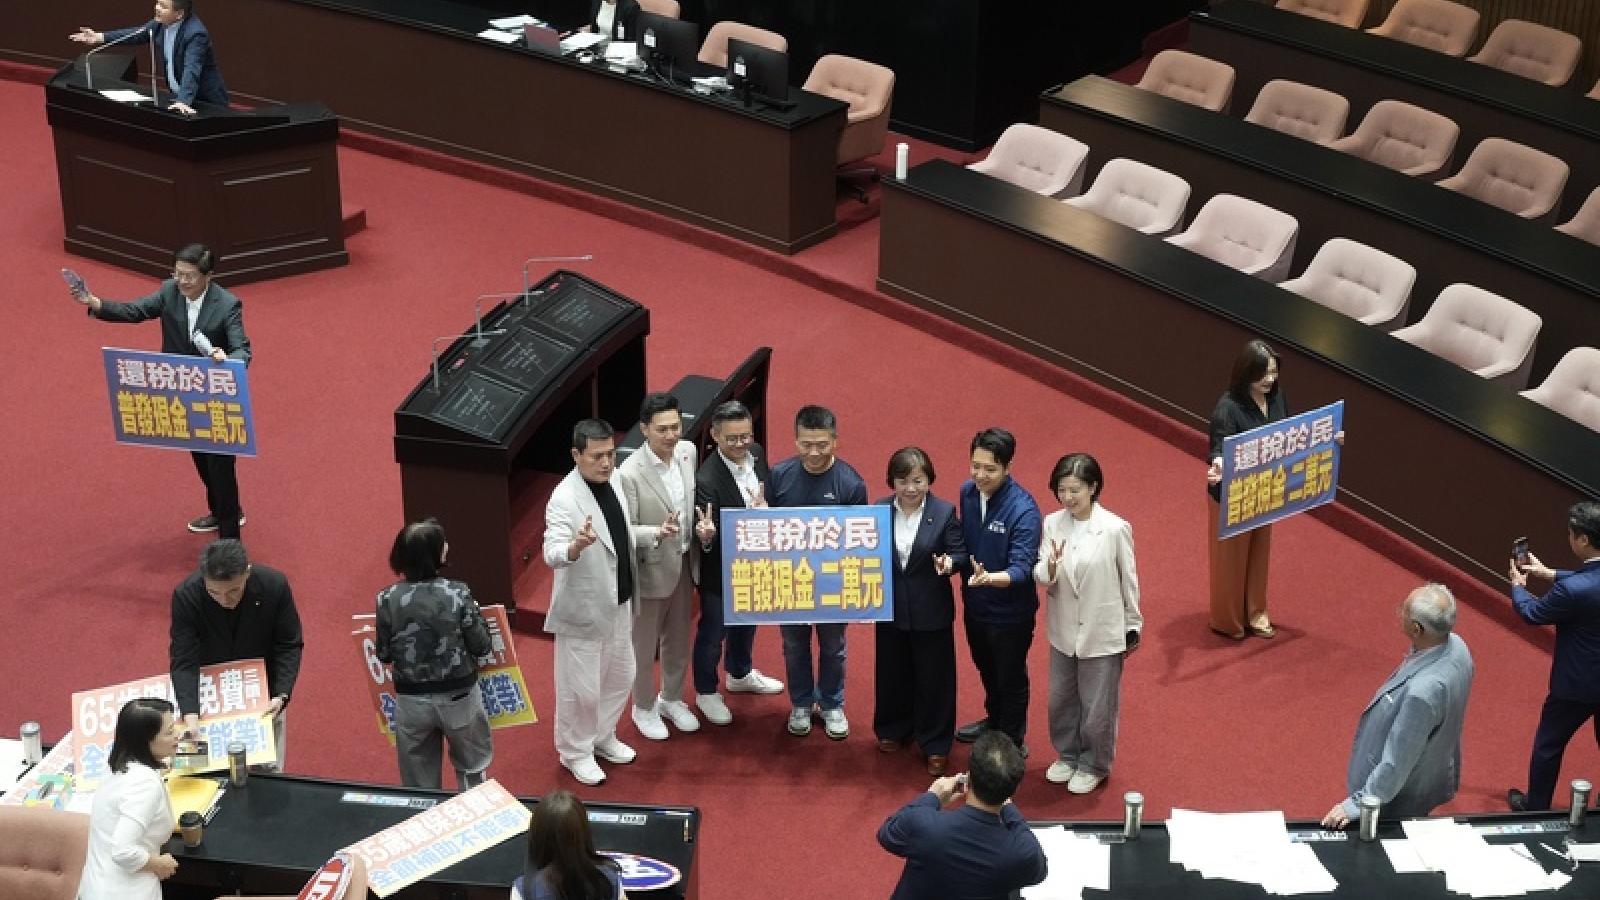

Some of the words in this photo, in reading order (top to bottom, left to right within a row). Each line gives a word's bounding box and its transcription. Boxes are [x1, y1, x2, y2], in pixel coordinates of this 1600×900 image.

[117, 358, 237, 396] 還稅於民
[117, 390, 190, 439] 普發現金
[192, 400, 247, 444] 二萬元
[1234, 414, 1333, 472] 還稅於民
[1226, 463, 1287, 526] 普發現金
[1288, 449, 1333, 502] 二萬元
[735, 516, 878, 552] 還稅於民
[731, 556, 815, 613] 普發現金
[821, 556, 883, 610] 二萬元
